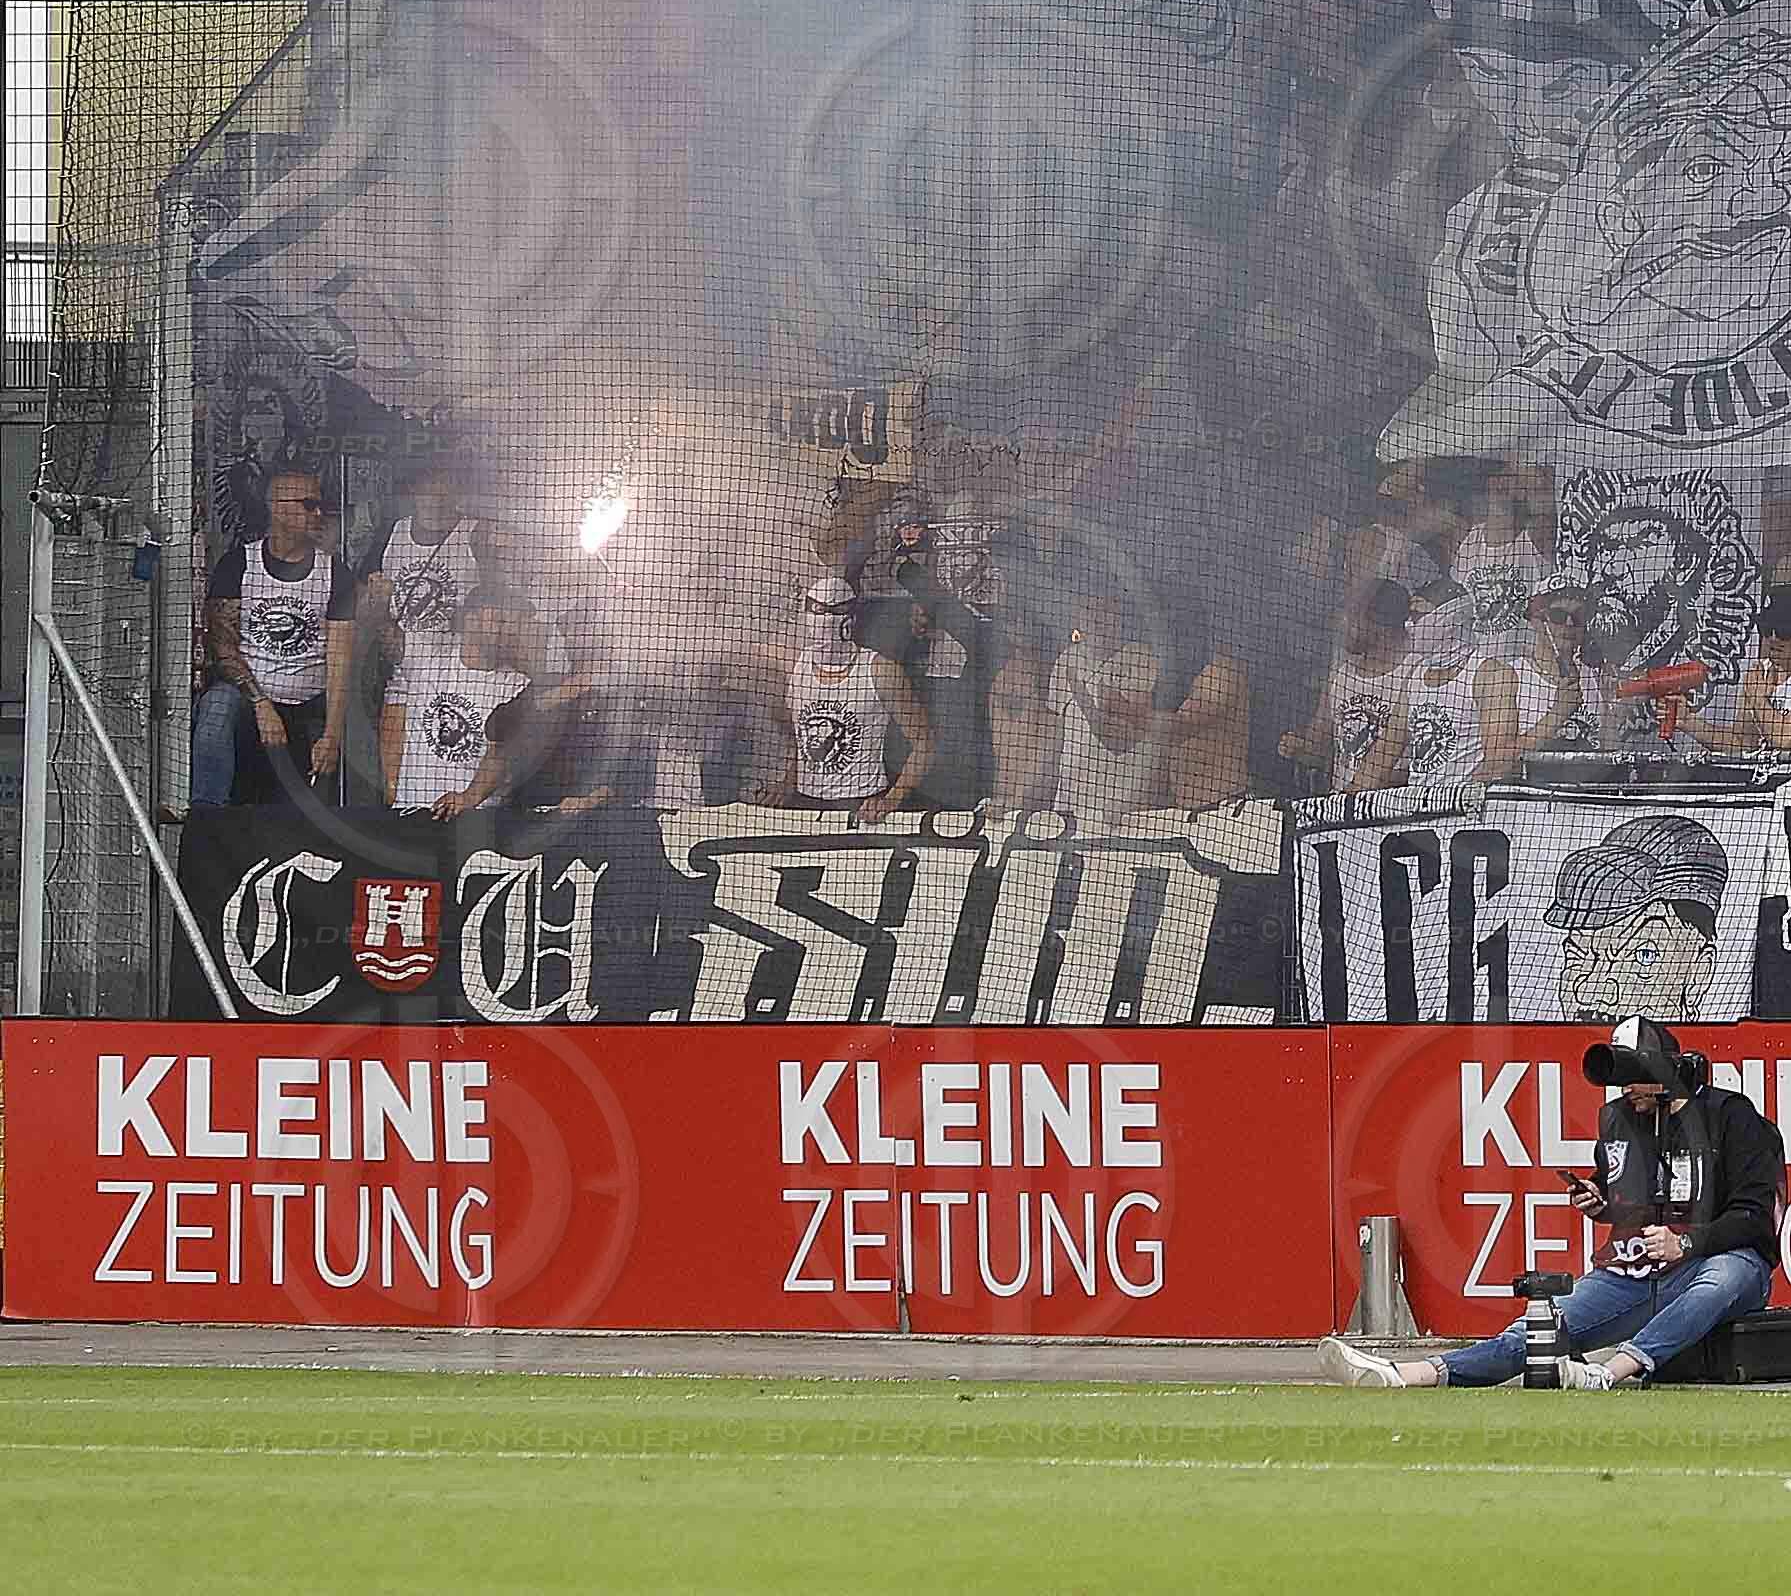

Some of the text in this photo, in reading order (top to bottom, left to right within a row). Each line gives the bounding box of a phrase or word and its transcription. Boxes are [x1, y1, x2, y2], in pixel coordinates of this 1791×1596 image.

[96, 1054, 491, 1162] KLEINE
[778, 1059, 1162, 1168] KLEINE
[94, 1179, 494, 1290] ZEITUNG
[782, 1187, 1164, 1298] ZEITUNG
